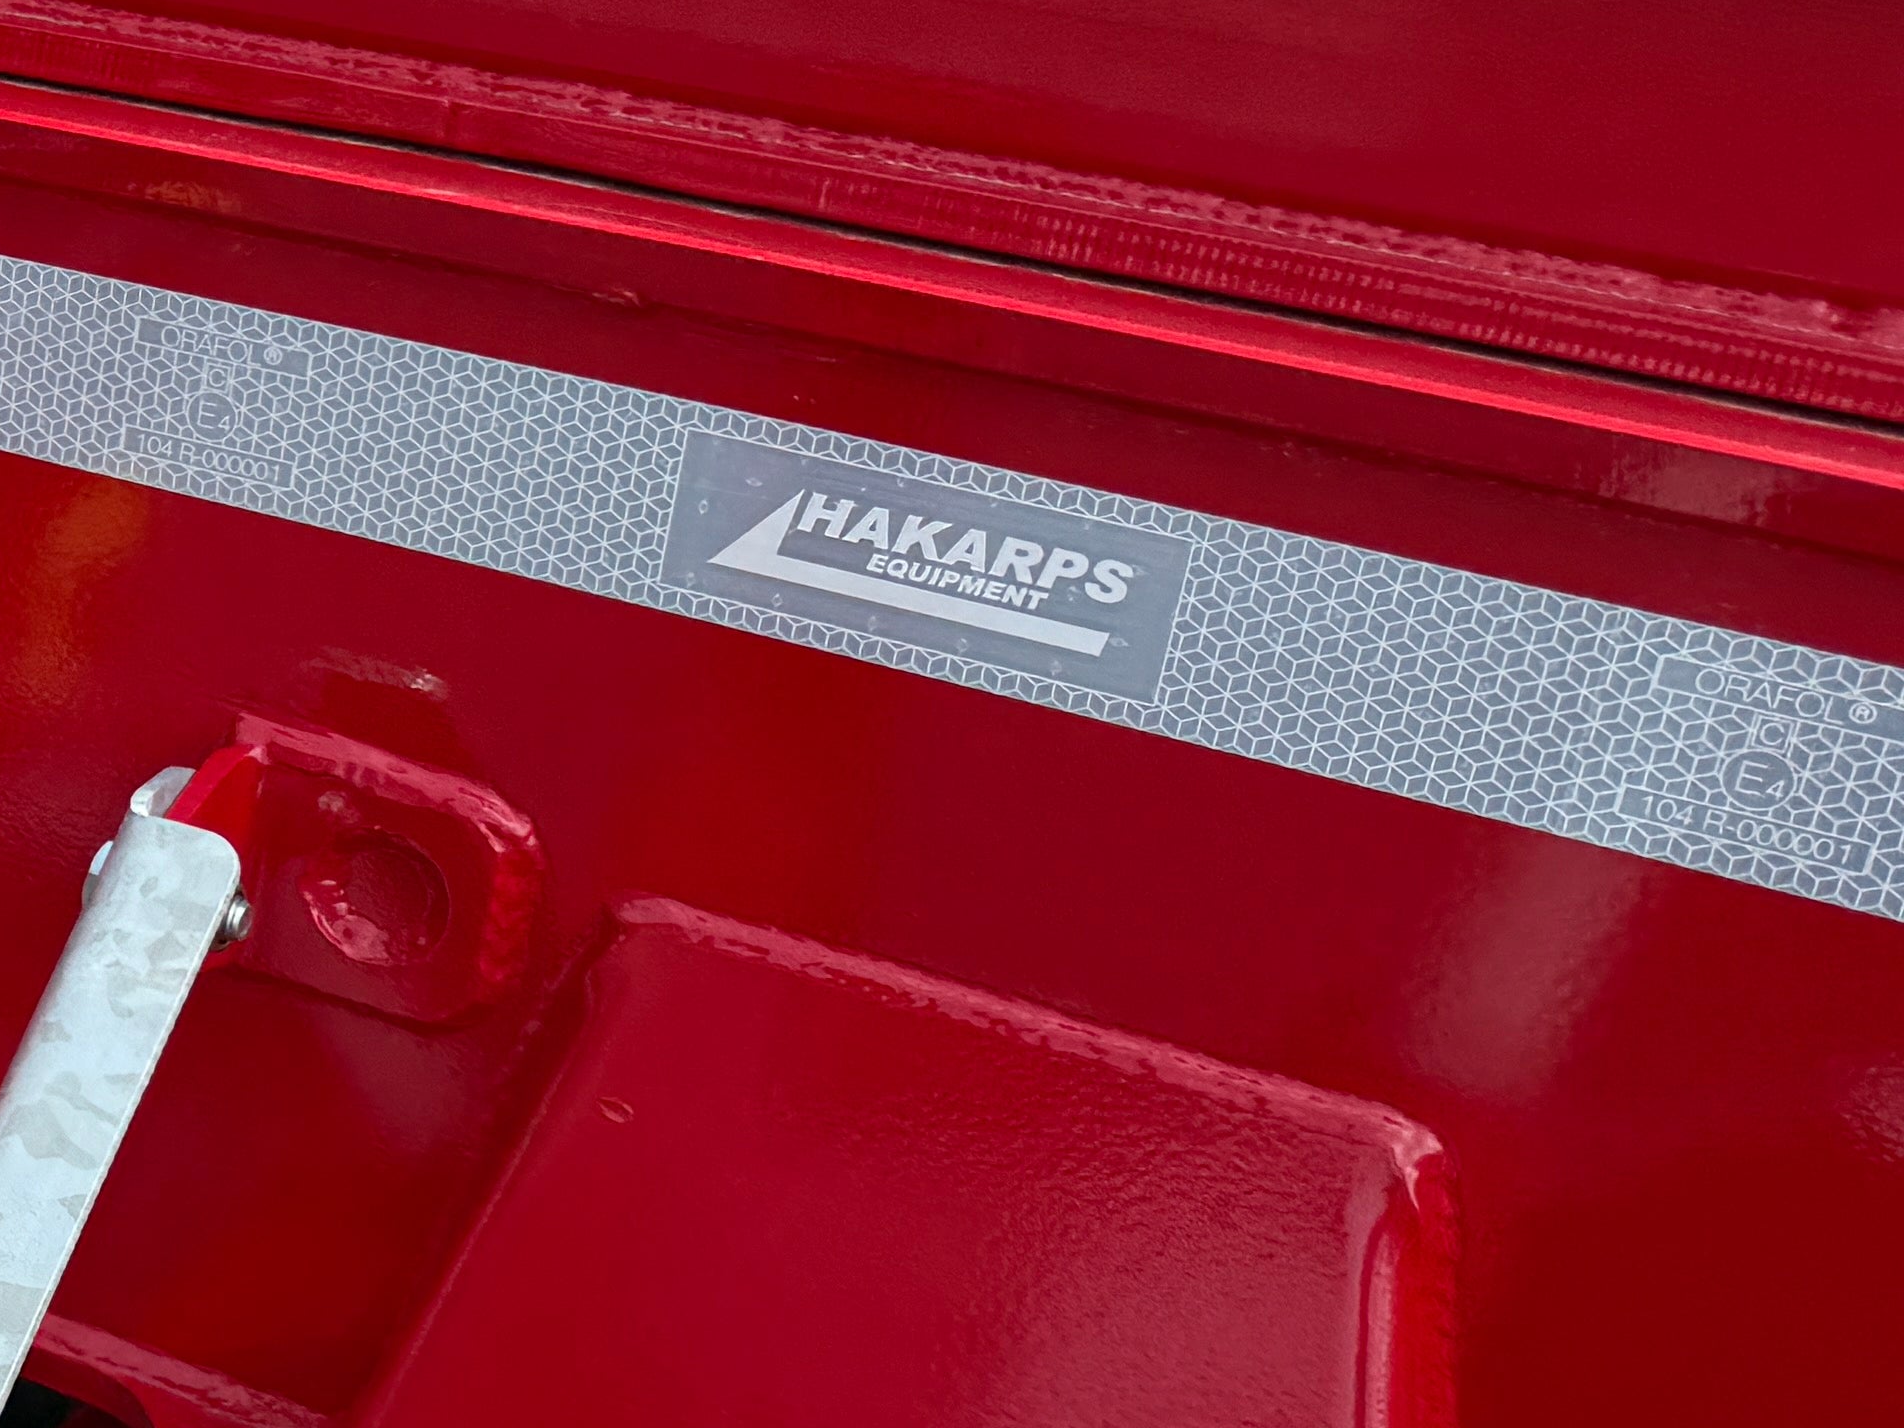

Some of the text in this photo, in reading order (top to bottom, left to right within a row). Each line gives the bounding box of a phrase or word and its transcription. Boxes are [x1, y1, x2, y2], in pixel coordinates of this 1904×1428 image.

[137, 433, 281, 482] 104 R-00001
[795, 491, 1135, 605] HAKARPS
[864, 553, 1049, 611] EQUIPMENT
[1759, 722, 1786, 746] C
[1734, 760, 1785, 801] E4
[1641, 795, 1854, 865] 104 R-00001
